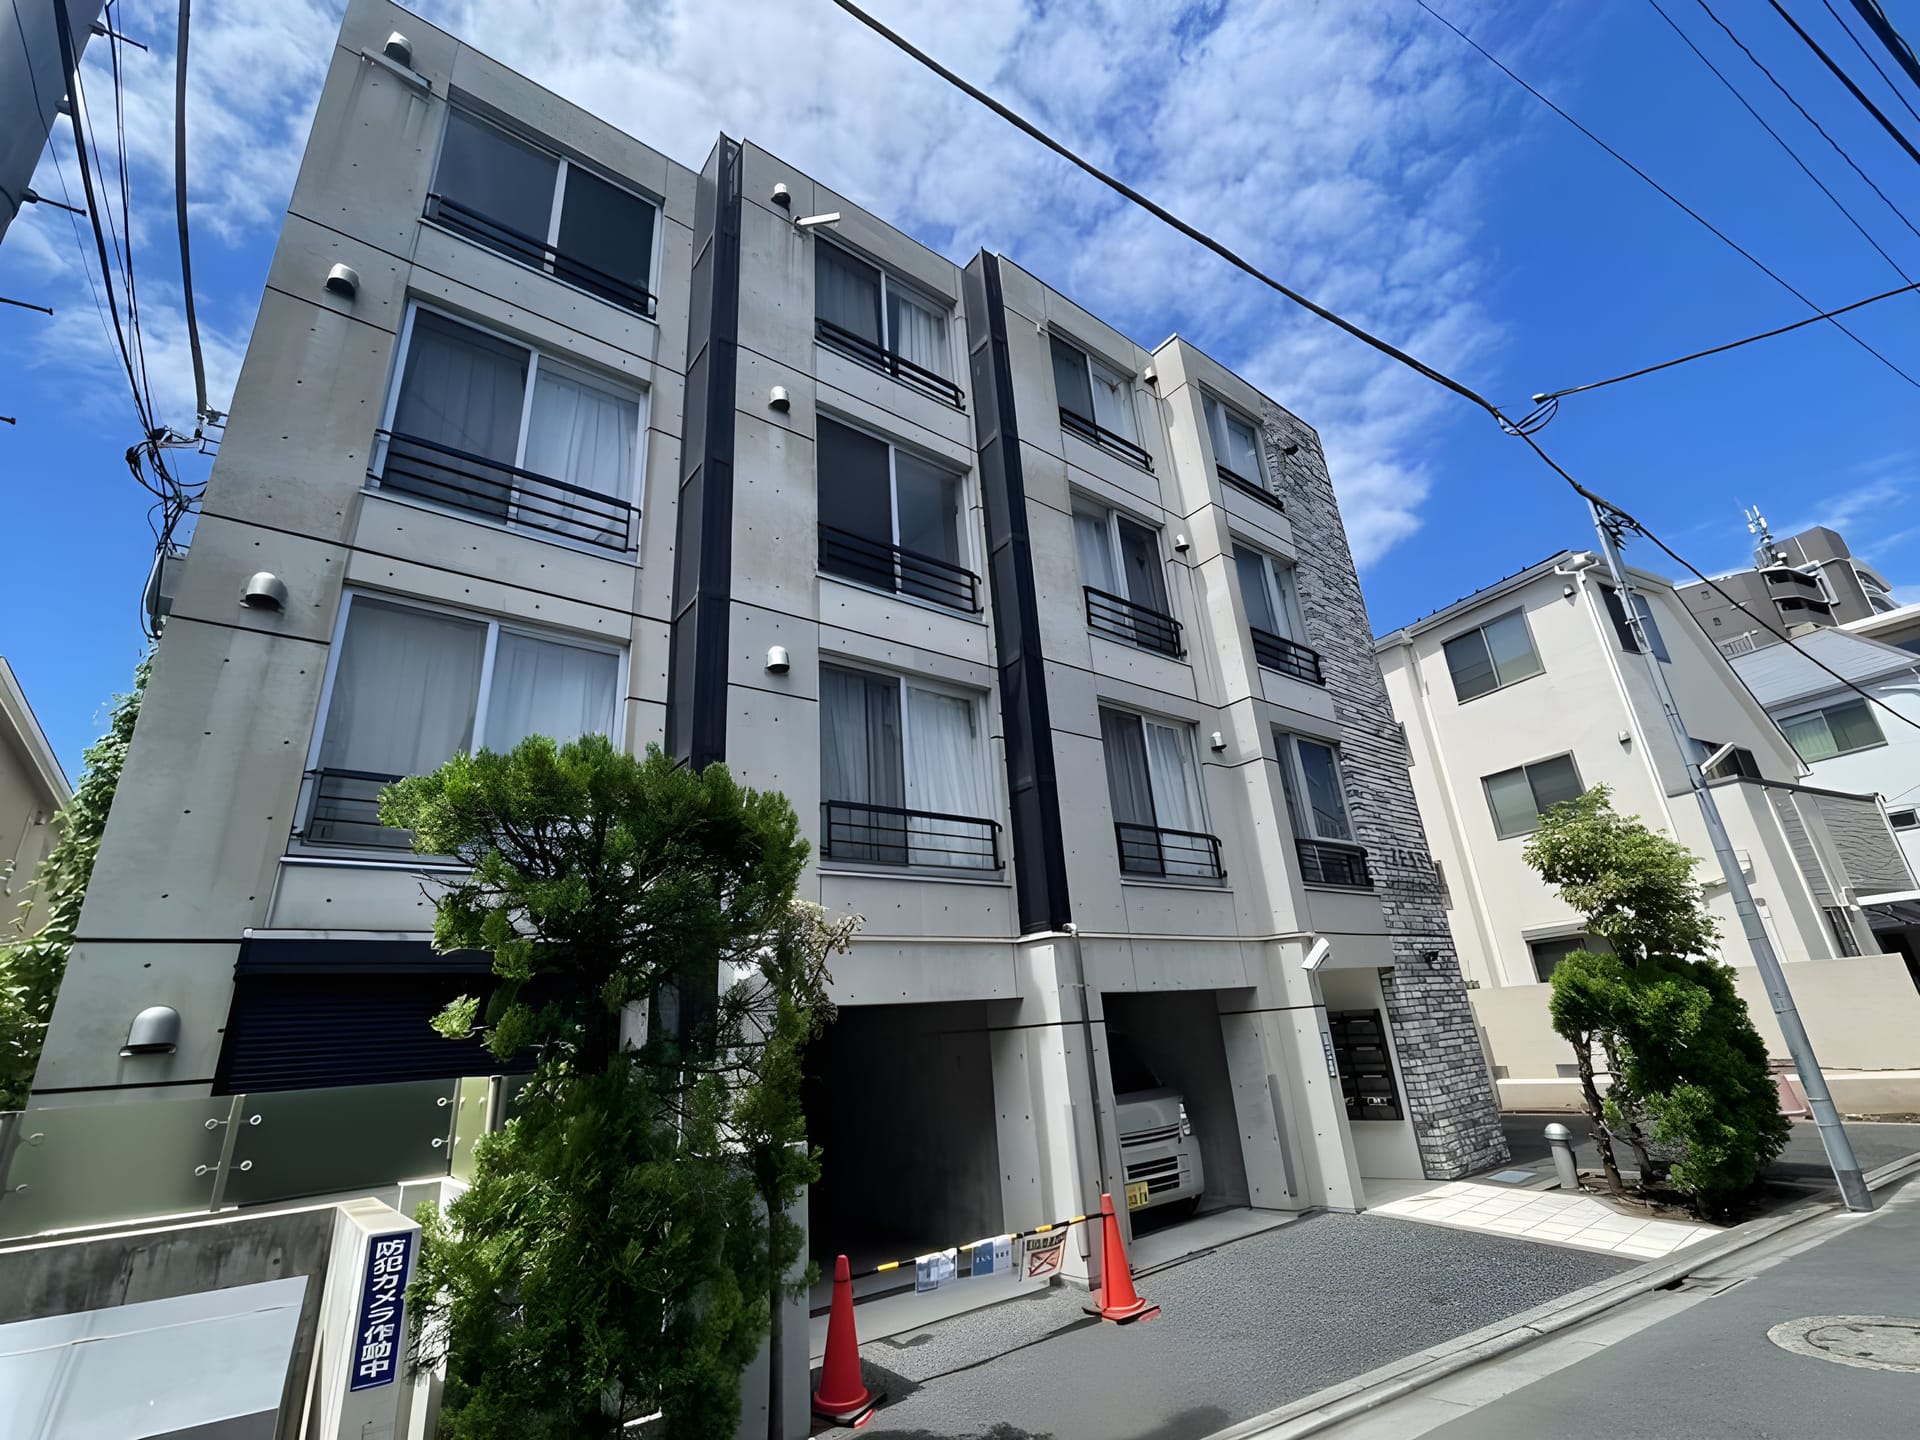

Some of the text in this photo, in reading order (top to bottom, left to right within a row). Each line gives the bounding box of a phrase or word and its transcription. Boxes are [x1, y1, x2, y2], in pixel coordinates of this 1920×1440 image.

[359, 1239, 406, 1378] 防犯カメラ作動中
